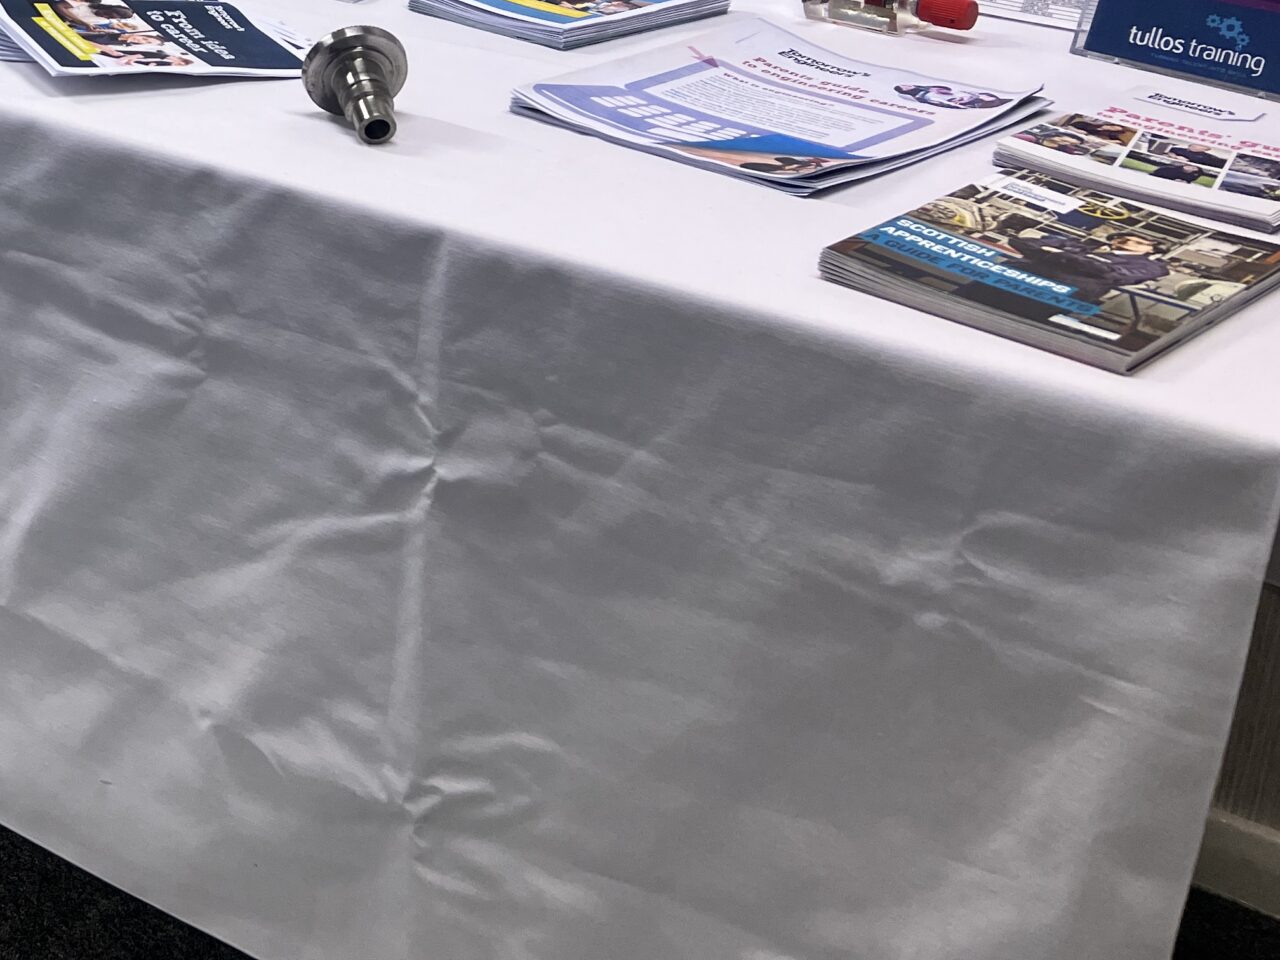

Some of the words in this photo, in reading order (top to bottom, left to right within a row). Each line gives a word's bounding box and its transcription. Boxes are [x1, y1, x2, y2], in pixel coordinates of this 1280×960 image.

[146, 10, 165, 22] to
[160, 23, 208, 53] career
[164, 10, 205, 39] From
[777, 51, 855, 78] Engineers
[787, 48, 872, 77] Tomorrow's
[1128, 25, 1185, 53] tullos
[1188, 39, 1266, 77] training
[742, 60, 757, 69] to
[761, 69, 865, 100] engineering
[869, 98, 936, 115] careers
[819, 80, 870, 94] guide
[896, 219, 996, 257] SCOTTISH
[880, 226, 1072, 294] APPRENTICESHIPS
[884, 239, 943, 265] GUIDE
[946, 262, 990, 281] FOR
[993, 278, 1092, 313] PARENTS
